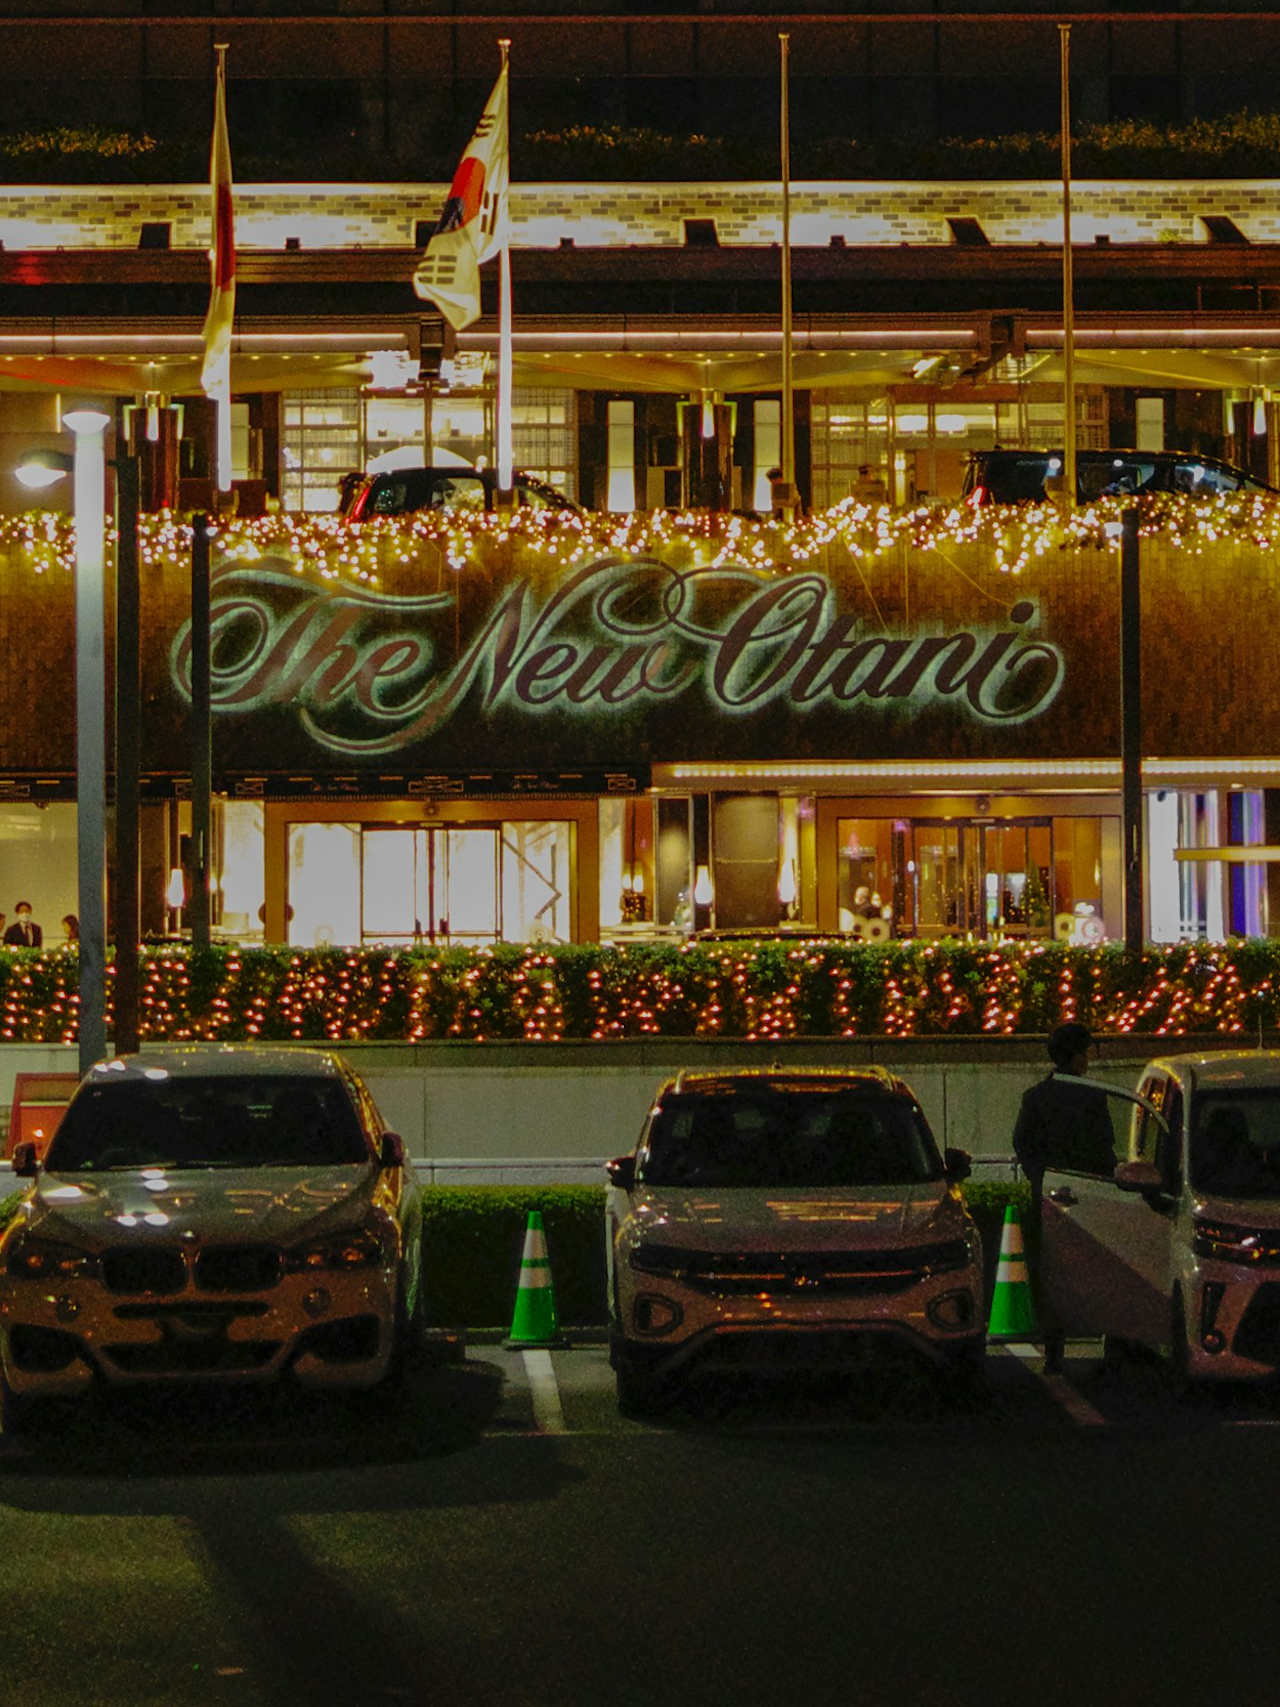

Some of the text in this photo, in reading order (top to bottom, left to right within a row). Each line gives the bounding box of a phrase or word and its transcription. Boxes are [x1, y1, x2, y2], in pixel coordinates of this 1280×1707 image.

[176, 556, 1060, 753] The New Otani
